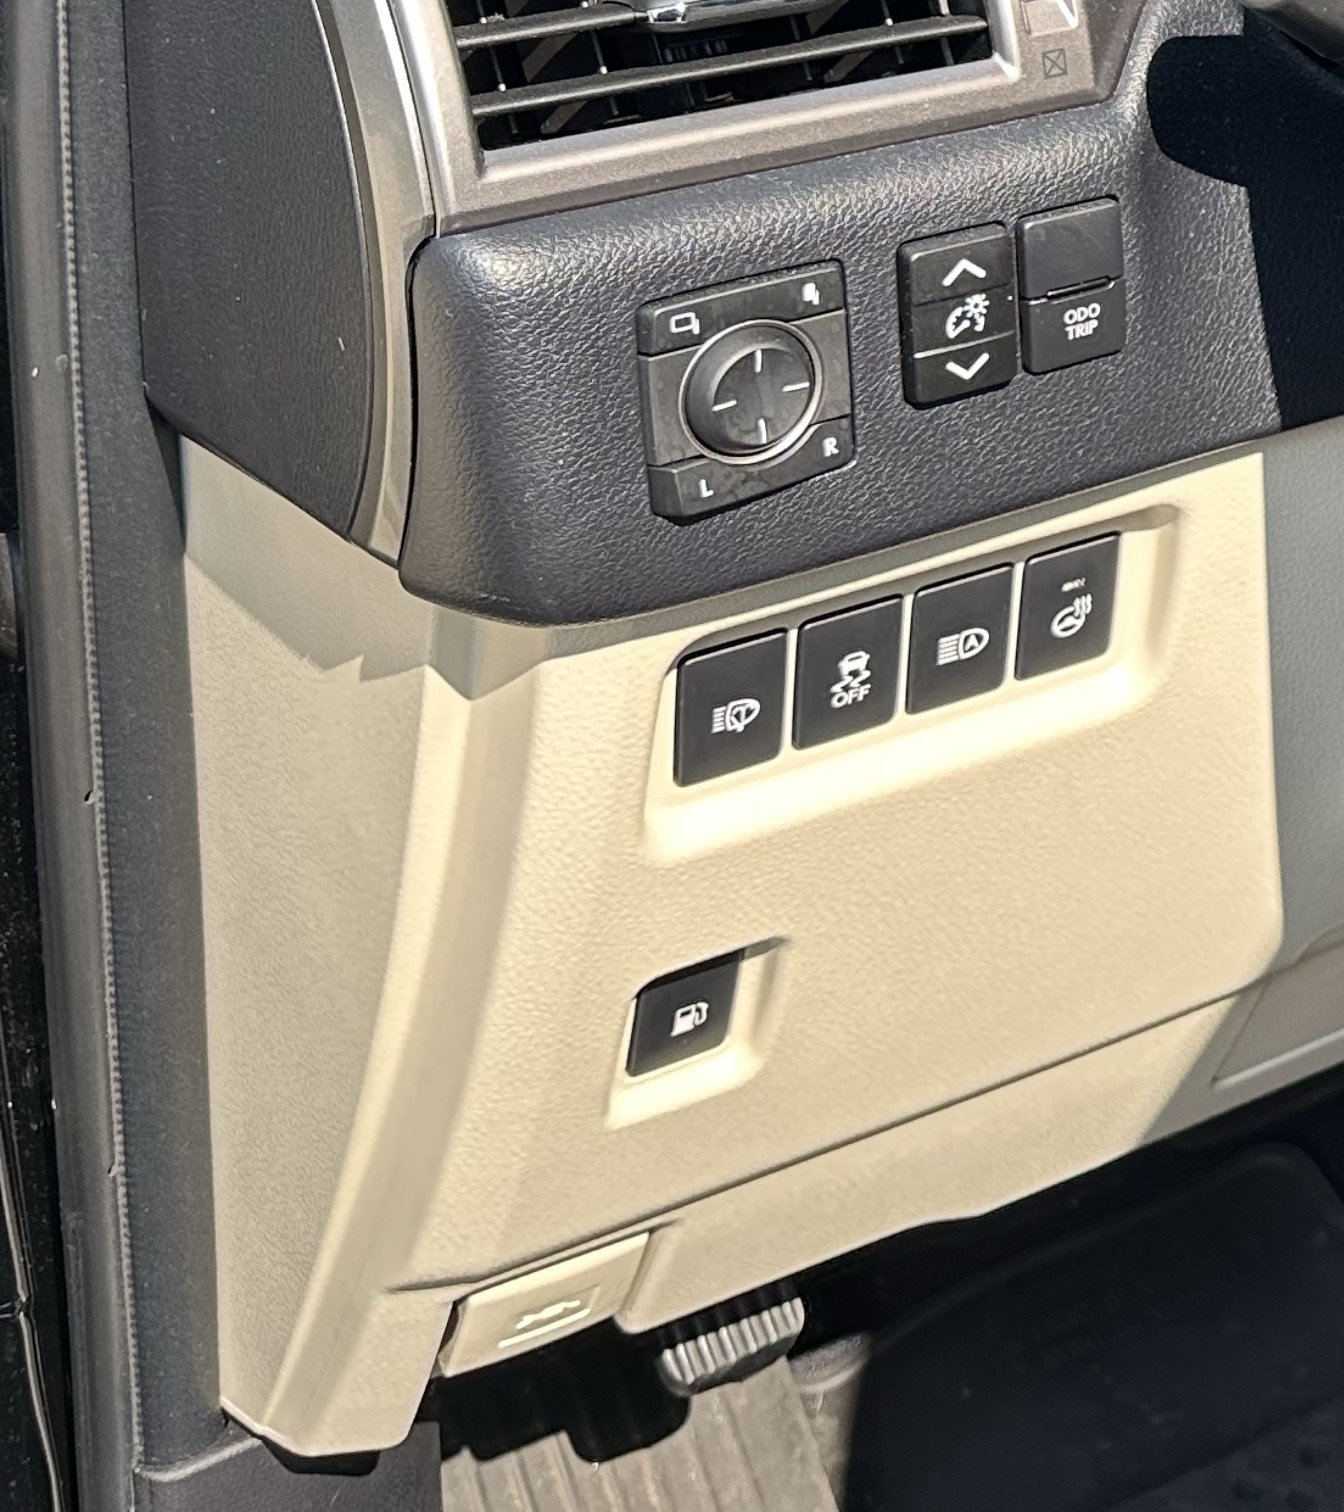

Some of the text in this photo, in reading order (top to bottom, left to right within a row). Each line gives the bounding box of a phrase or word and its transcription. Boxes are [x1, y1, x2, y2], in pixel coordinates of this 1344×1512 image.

[1063, 302, 1101, 325] ODO
[1065, 319, 1099, 341] TRIP
[822, 437, 839, 457] R
[698, 479, 714, 498] L
[830, 683, 872, 709] OFF
